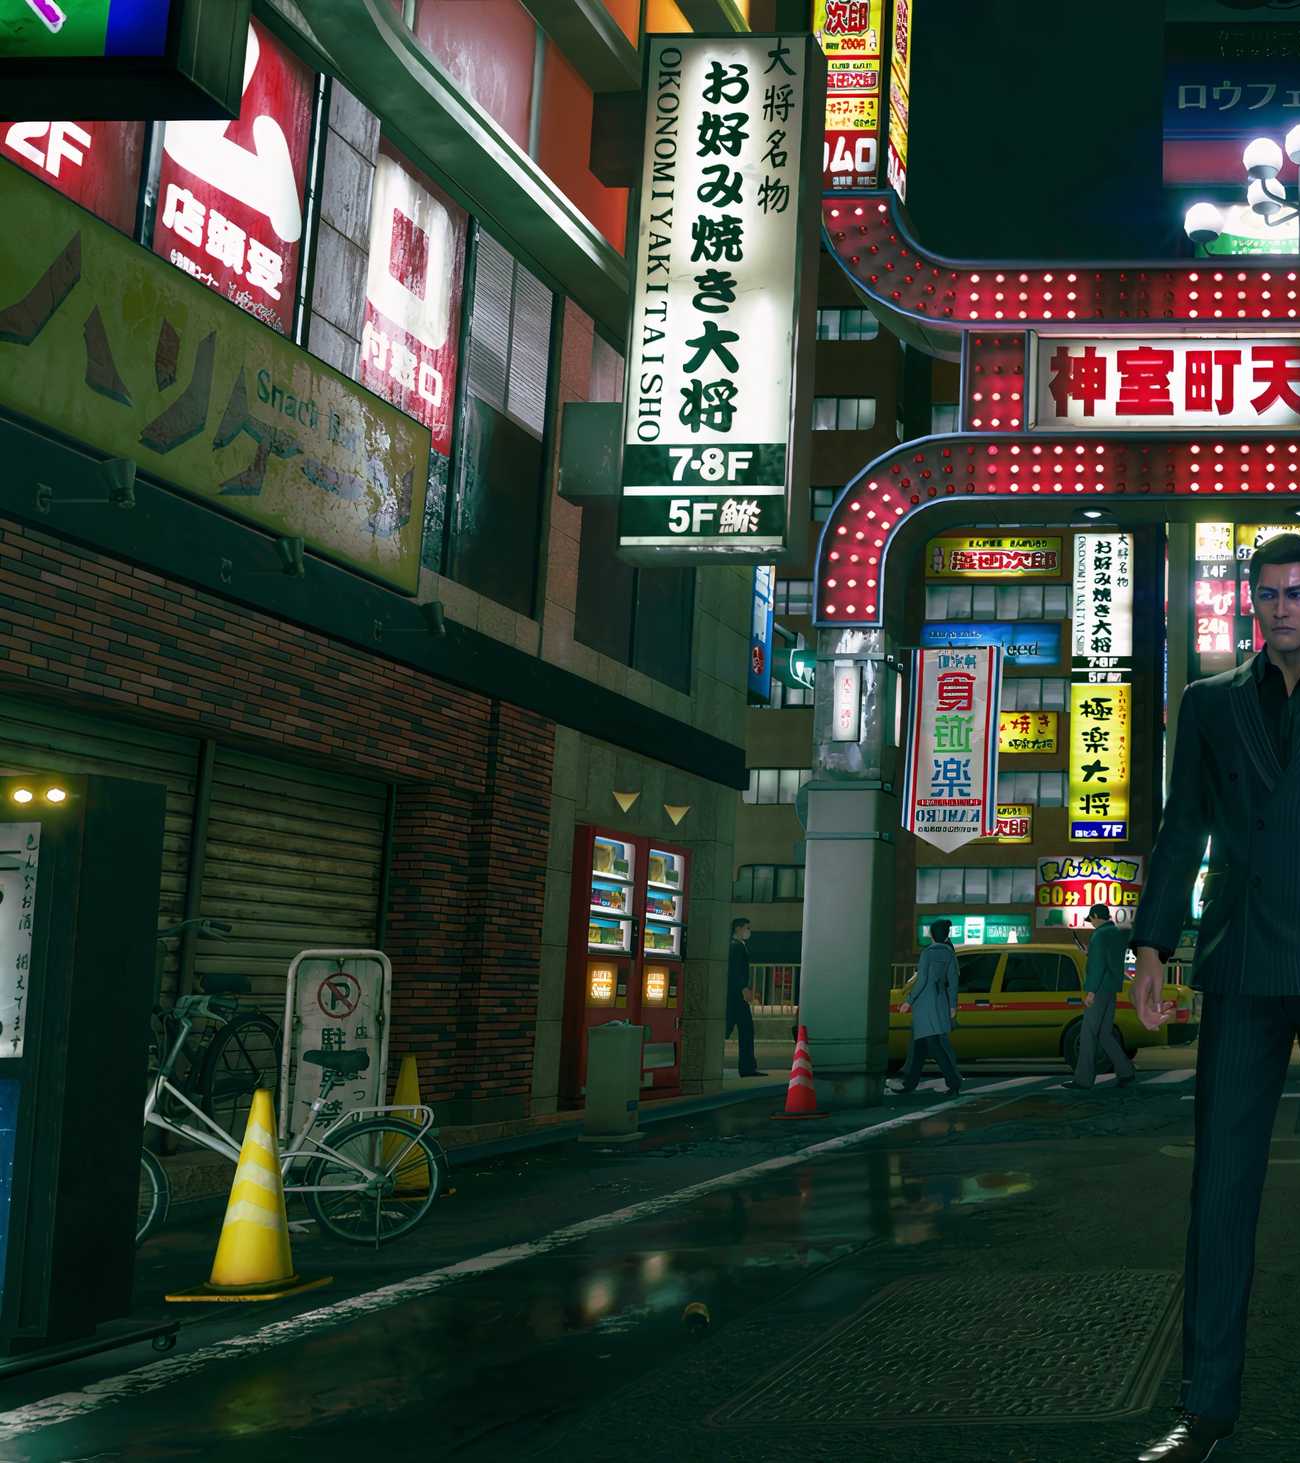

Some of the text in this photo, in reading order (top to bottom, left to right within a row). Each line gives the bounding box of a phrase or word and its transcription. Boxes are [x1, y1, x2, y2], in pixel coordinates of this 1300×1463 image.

[679, 61, 750, 434] お好み焼き大将
[1091, 540, 1112, 653] お好み焼き大将
[1000, 713, 1050, 735] 焼き
[1102, 824, 1123, 837] 7F
